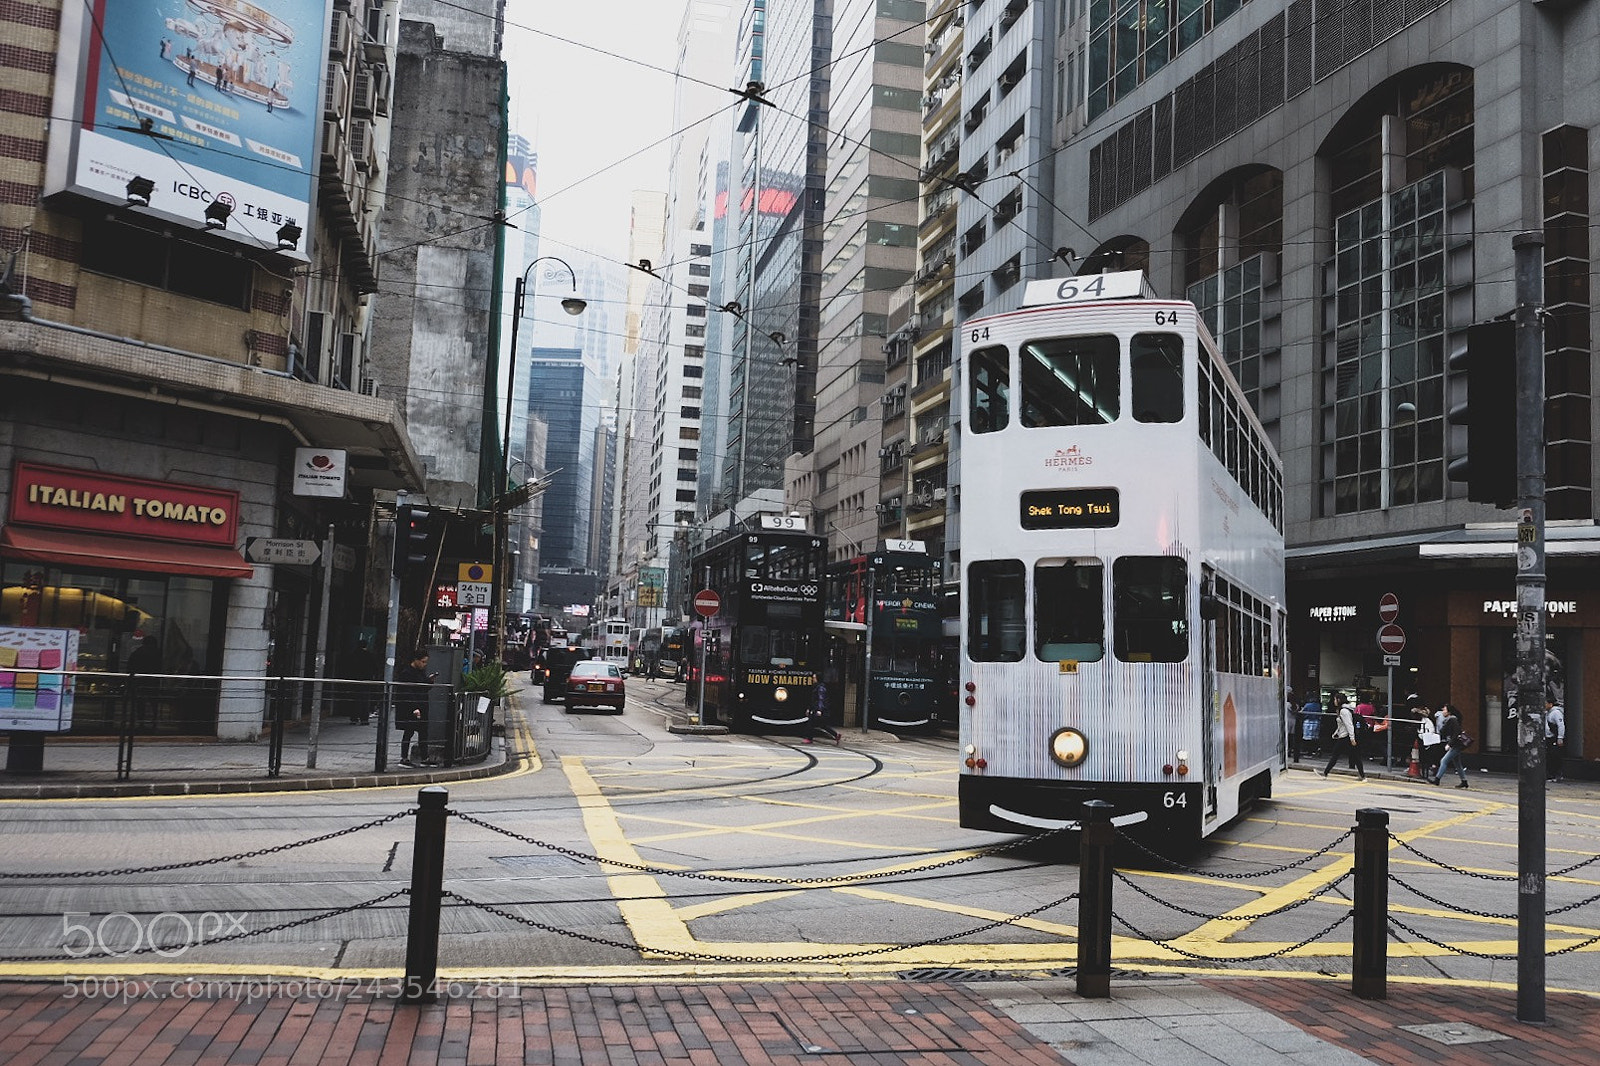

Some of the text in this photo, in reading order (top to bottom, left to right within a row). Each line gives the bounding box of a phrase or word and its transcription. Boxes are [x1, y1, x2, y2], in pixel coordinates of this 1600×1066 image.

[173, 180, 211, 204] ICBC
[1056, 275, 1106, 301] 64
[1154, 310, 1178, 326] 64
[971, 326, 990, 344] 64
[29, 483, 227, 525] ITALIAN TOMATO
[1028, 503, 1111, 516] Shek Tong Tsui
[773, 517, 794, 529] 99
[265, 540, 294, 548] Morrison
[898, 540, 915, 551] 62
[461, 584, 473, 592] 24
[475, 585, 488, 593] hrs
[464, 593, 485, 604] 全日
[1309, 605, 1357, 618] PAPER STONE
[1483, 600, 1518, 613] PAPE
[748, 674, 813, 686] NOW SMARTER
[1162, 791, 1187, 809] 64
